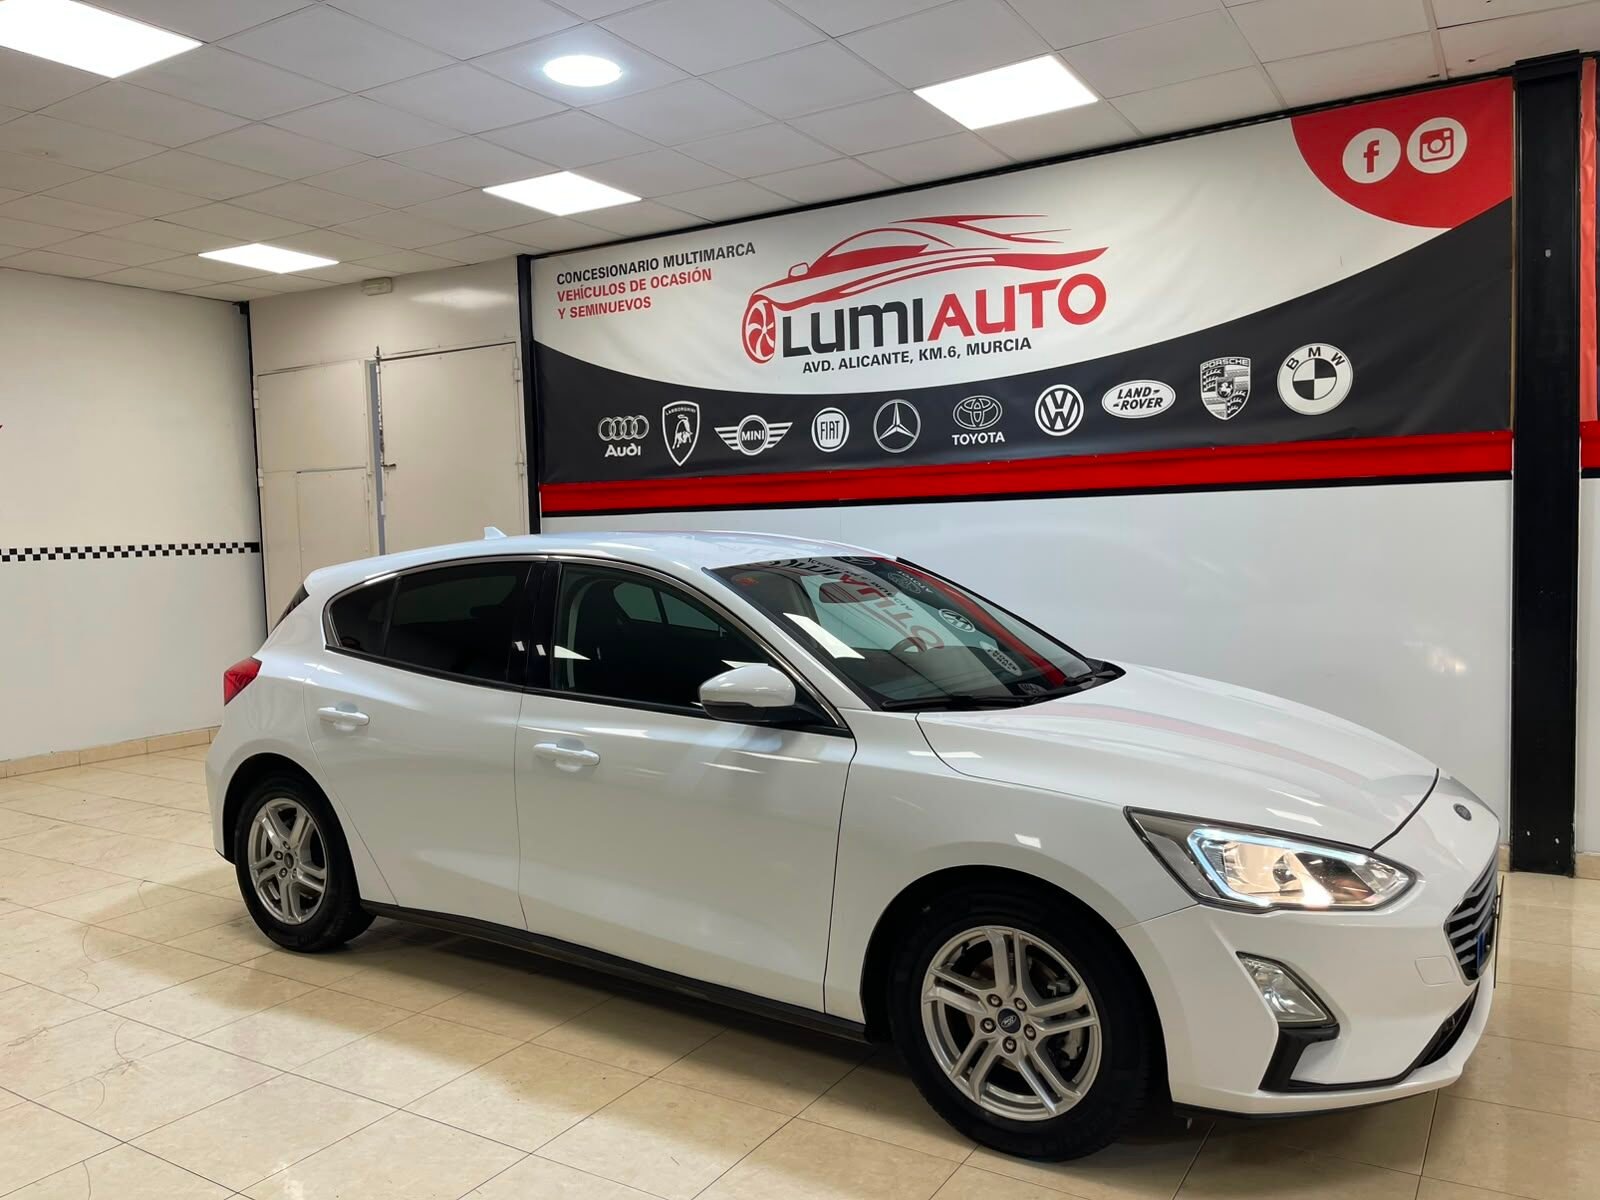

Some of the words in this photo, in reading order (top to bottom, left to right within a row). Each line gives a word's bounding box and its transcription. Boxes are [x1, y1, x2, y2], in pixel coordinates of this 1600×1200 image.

[556, 257, 660, 285] CONCESIONARIO
[663, 242, 756, 269] MULTIMARCA
[557, 282, 626, 302] VEHÍCULOS
[630, 279, 646, 293] DE
[650, 266, 712, 289] OCASIÓN
[558, 307, 566, 320] Y
[569, 296, 652, 319] SEMINUEVOS
[802, 359, 835, 374] AVD.
[838, 351, 914, 371] ALICANTE,
[918, 345, 961, 361] KM.6,
[966, 337, 1032, 356] MURCIA
[1201, 358, 1250, 371] PORSCHE
[741, 430, 765, 442] MINI
[820, 419, 841, 442] FIAT
[951, 431, 1005, 446] TOYOTA
[604, 443, 641, 458] Audi
